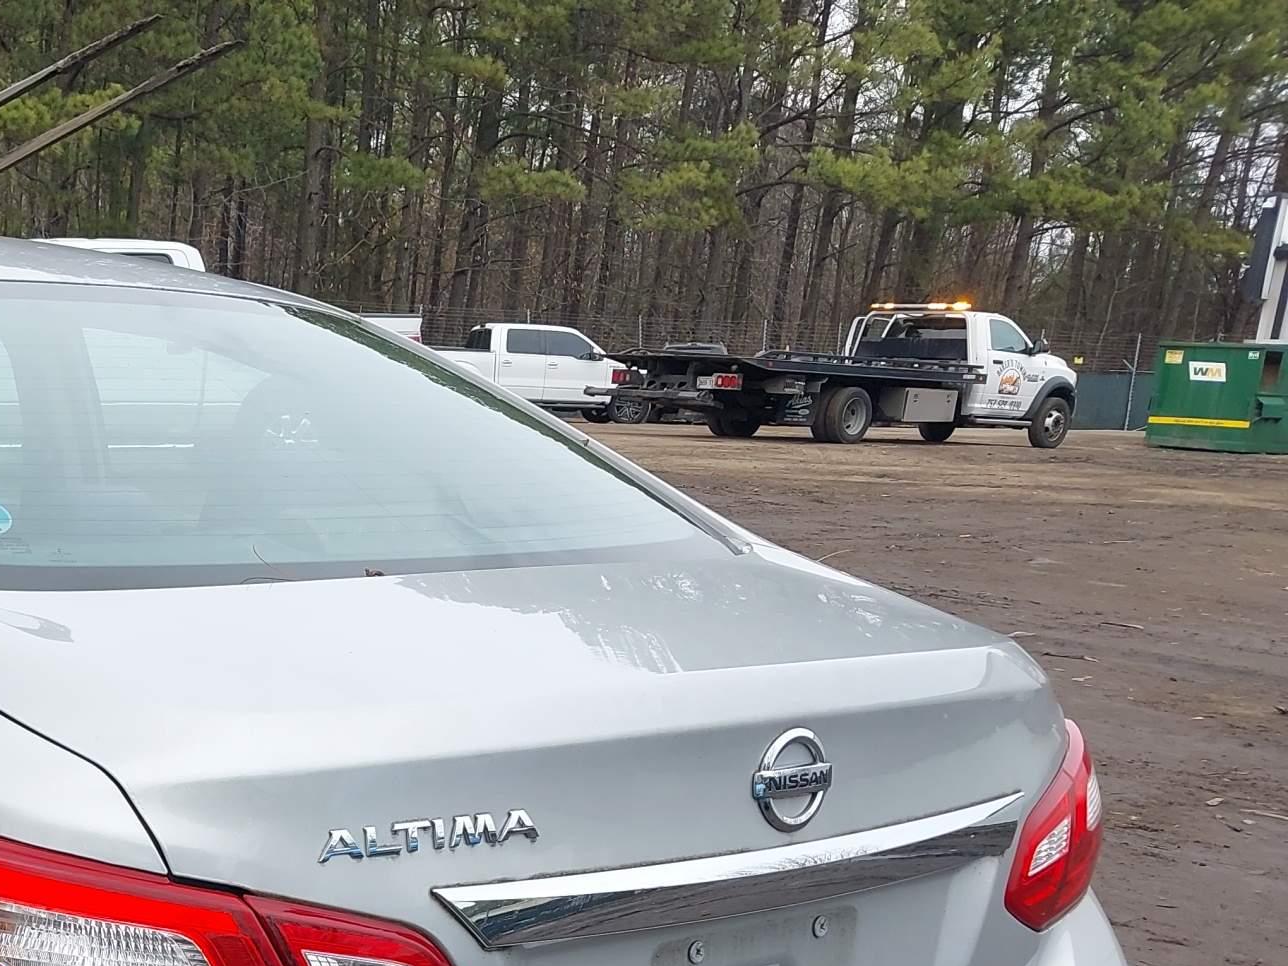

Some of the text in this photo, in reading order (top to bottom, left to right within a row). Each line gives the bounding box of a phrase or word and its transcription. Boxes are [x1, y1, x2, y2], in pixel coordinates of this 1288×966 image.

[1193, 366, 1223, 378] WM
[767, 769, 829, 792] NISSAN
[317, 808, 540, 864] ALTIMA
